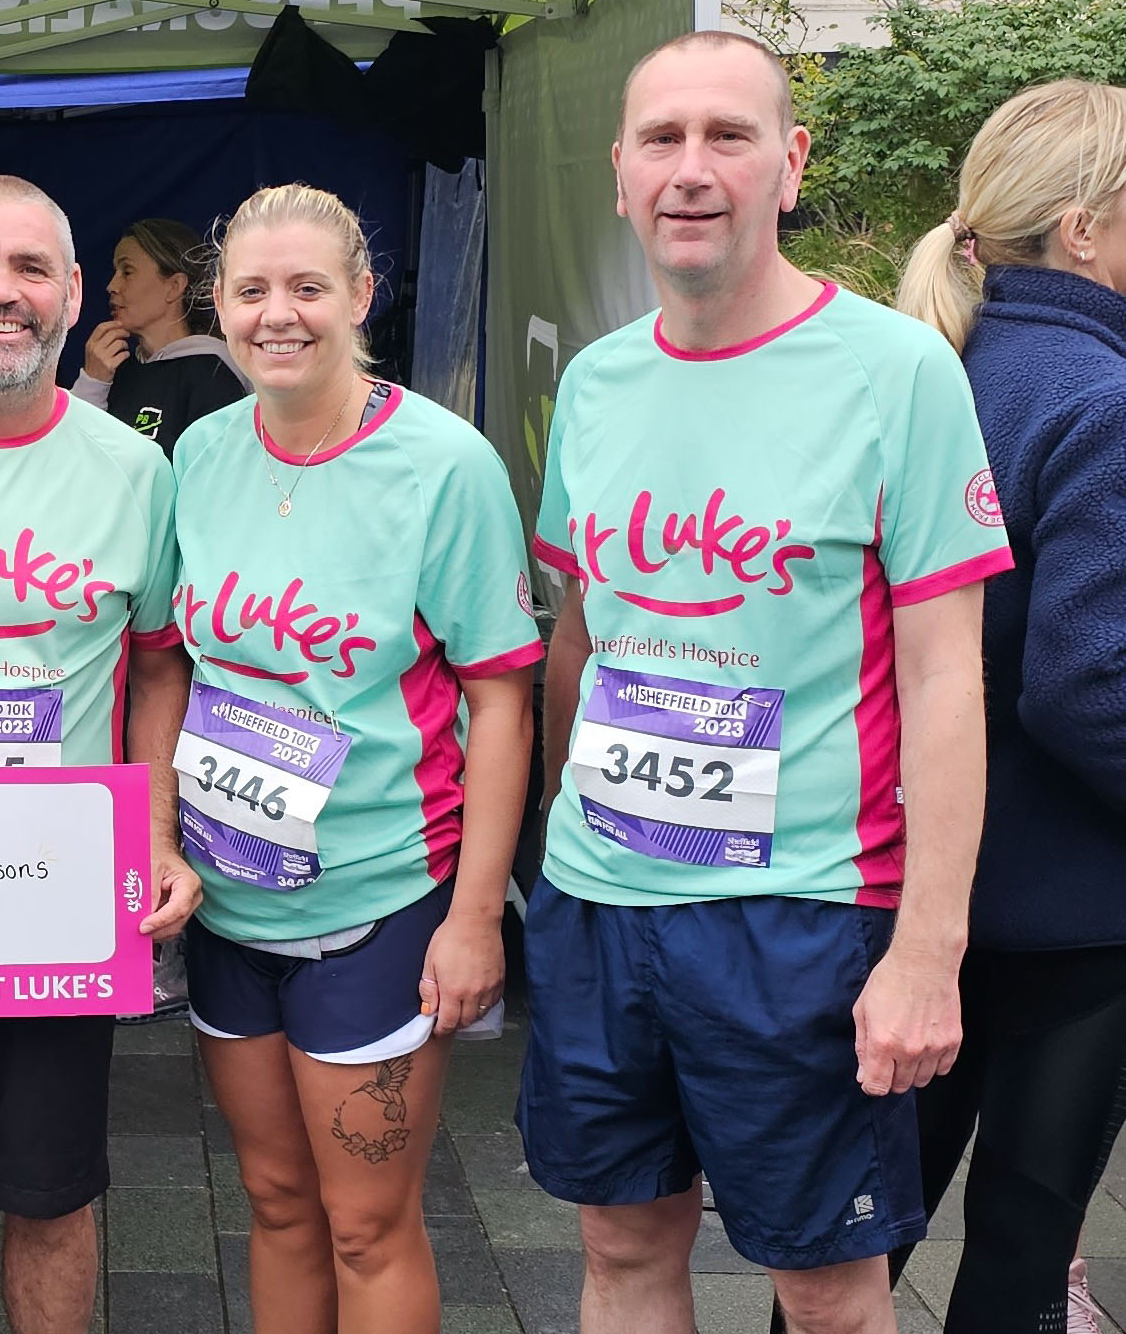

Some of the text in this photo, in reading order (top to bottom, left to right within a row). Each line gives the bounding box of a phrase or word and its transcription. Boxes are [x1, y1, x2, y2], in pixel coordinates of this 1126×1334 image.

[628, 487, 816, 595] Luke's
[211, 570, 377, 678] Luke's
[590, 635, 760, 668] heffield's Hospice
[6, 703, 32, 716] 10K
[638, 688, 744, 717] SHEFFIELD 10K
[233, 708, 319, 751] SHEFFIELD 10K
[692, 717, 745, 738] 2023
[270, 743, 313, 769] 2023
[198, 755, 289, 821] 3446
[601, 743, 734, 803] 3452
[13, 973, 114, 999] LUKE'S
